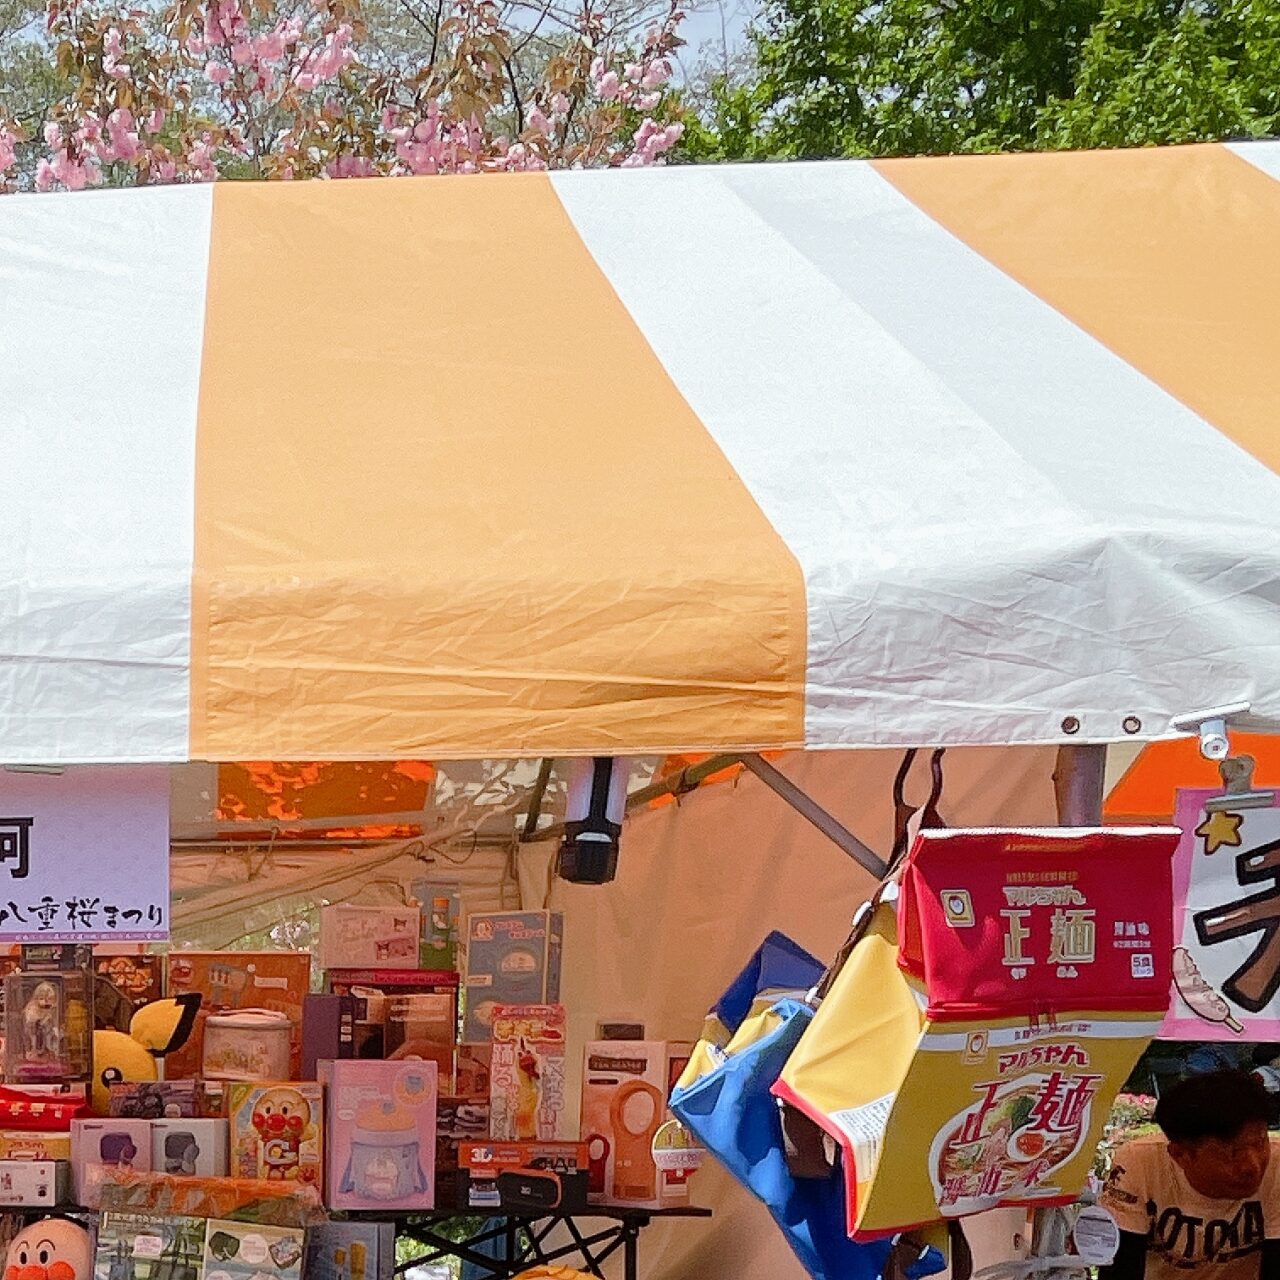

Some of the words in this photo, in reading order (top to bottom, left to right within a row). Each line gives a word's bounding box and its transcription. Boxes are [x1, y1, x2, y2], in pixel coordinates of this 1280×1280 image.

[1002, 885, 1087, 907] マルちゃん
[1000, 908, 1096, 966] 正麺
[999, 1045, 1088, 1073] マルちゃん
[950, 1071, 1103, 1149] 正麺
